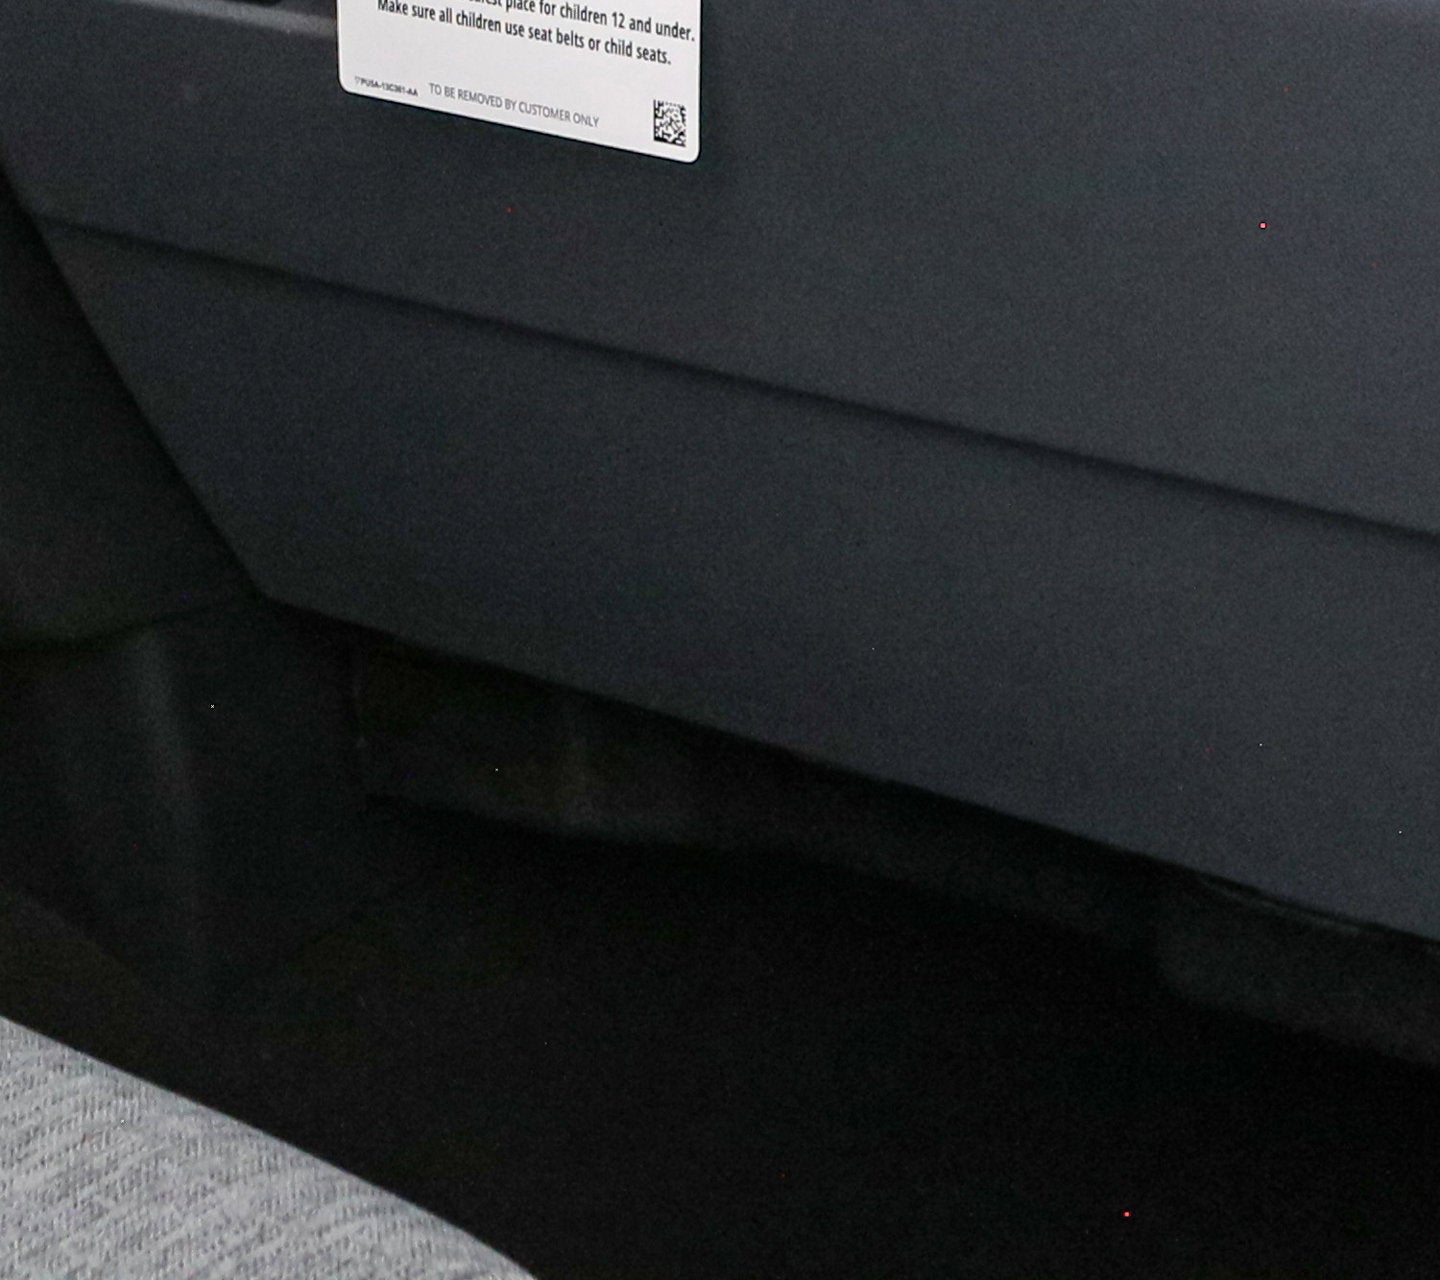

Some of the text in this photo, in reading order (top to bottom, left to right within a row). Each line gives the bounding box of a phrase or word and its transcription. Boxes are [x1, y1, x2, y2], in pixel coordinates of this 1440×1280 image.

[412, 6, 436, 21] sure
[439, 7, 453, 24] all
[456, 10, 502, 34] children
[505, 21, 525, 37] use
[528, 25, 553, 43] seat
[556, 28, 585, 49] belts
[588, 37, 601, 52] or
[604, 37, 633, 58] child
[636, 45, 672, 66] seats.
[560, 1, 608, 26] children
[611, 11, 626, 29] 12
[629, 17, 652, 34] and
[655, 21, 695, 42] under.
[429, 82, 600, 129] TO BE REMOVED BY CUSTOMER ONLY
